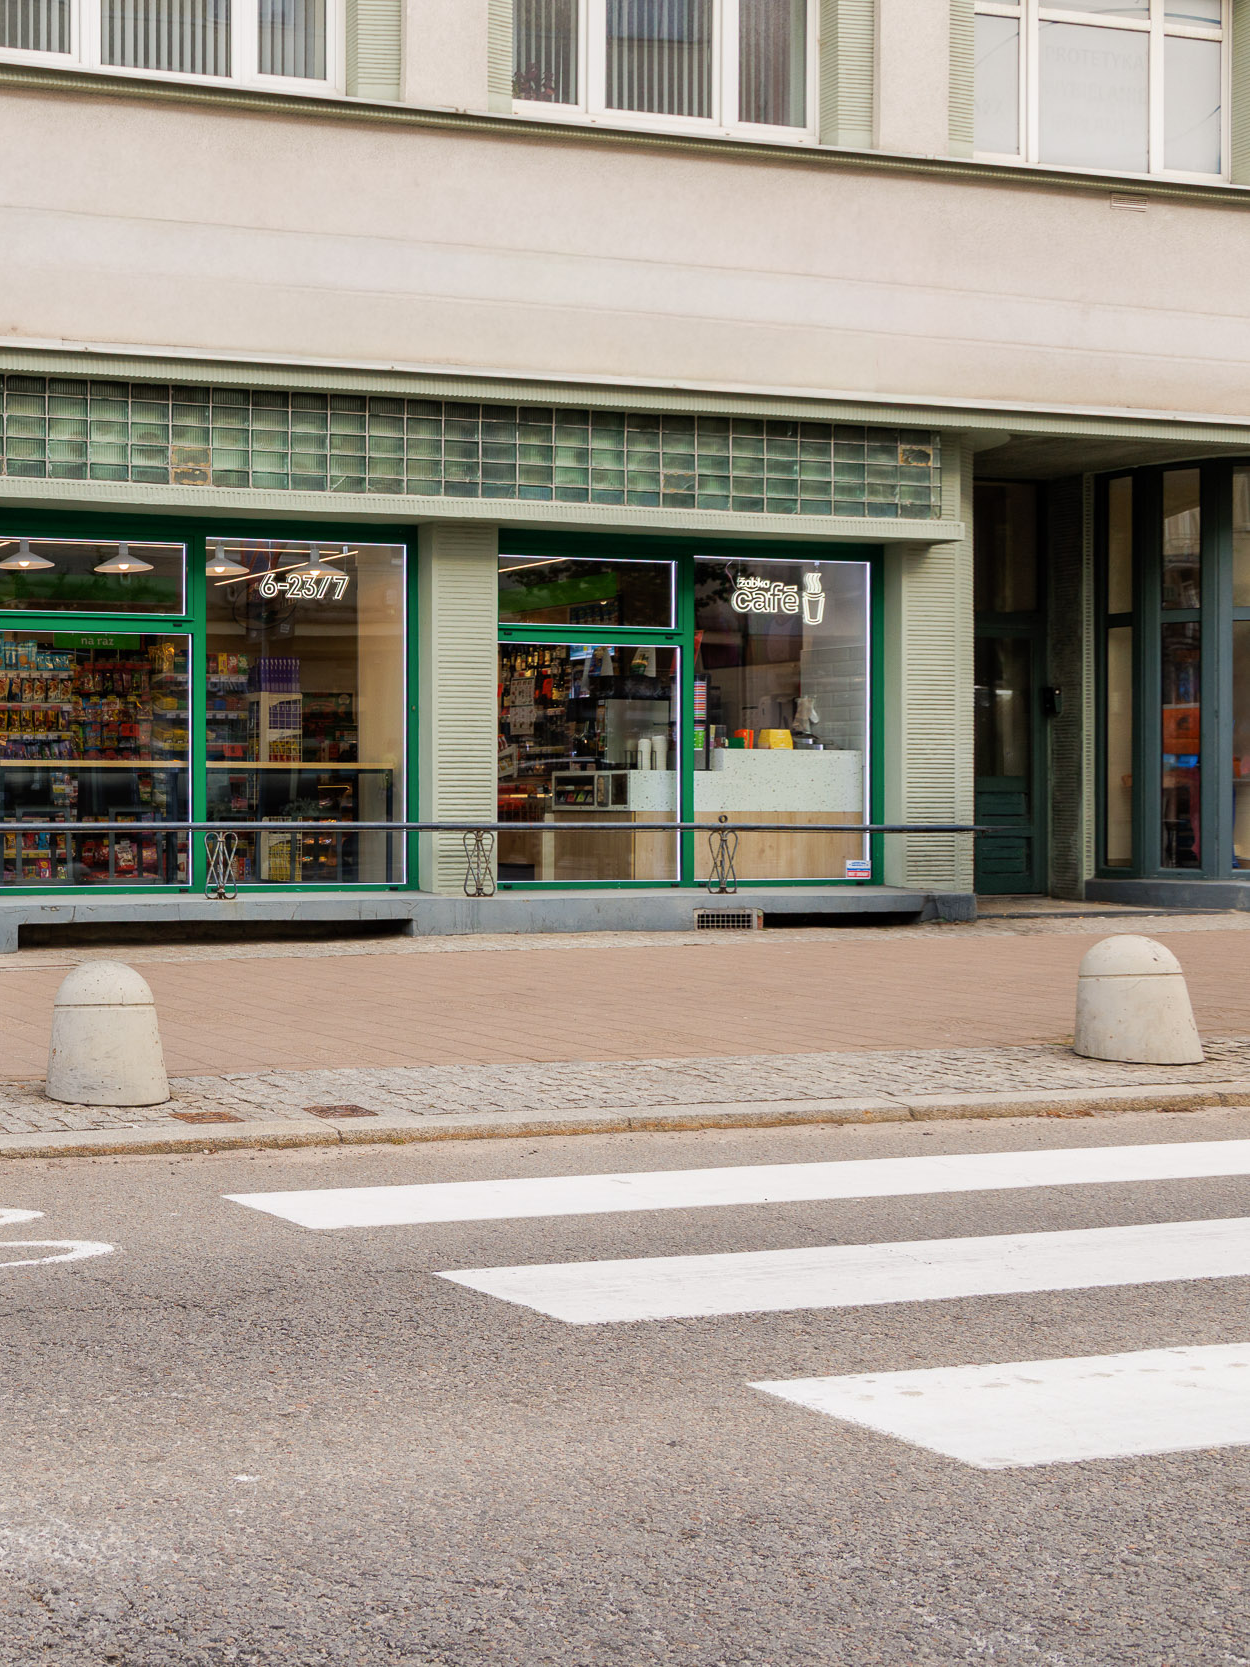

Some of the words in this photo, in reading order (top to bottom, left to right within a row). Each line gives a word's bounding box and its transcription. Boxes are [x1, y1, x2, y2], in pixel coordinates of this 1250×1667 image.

[1045, 45, 1145, 72] PROTETYKA
[259, 573, 350, 600] 6-23/7
[737, 576, 770, 589] żabka
[97, 638, 115, 646] raz
